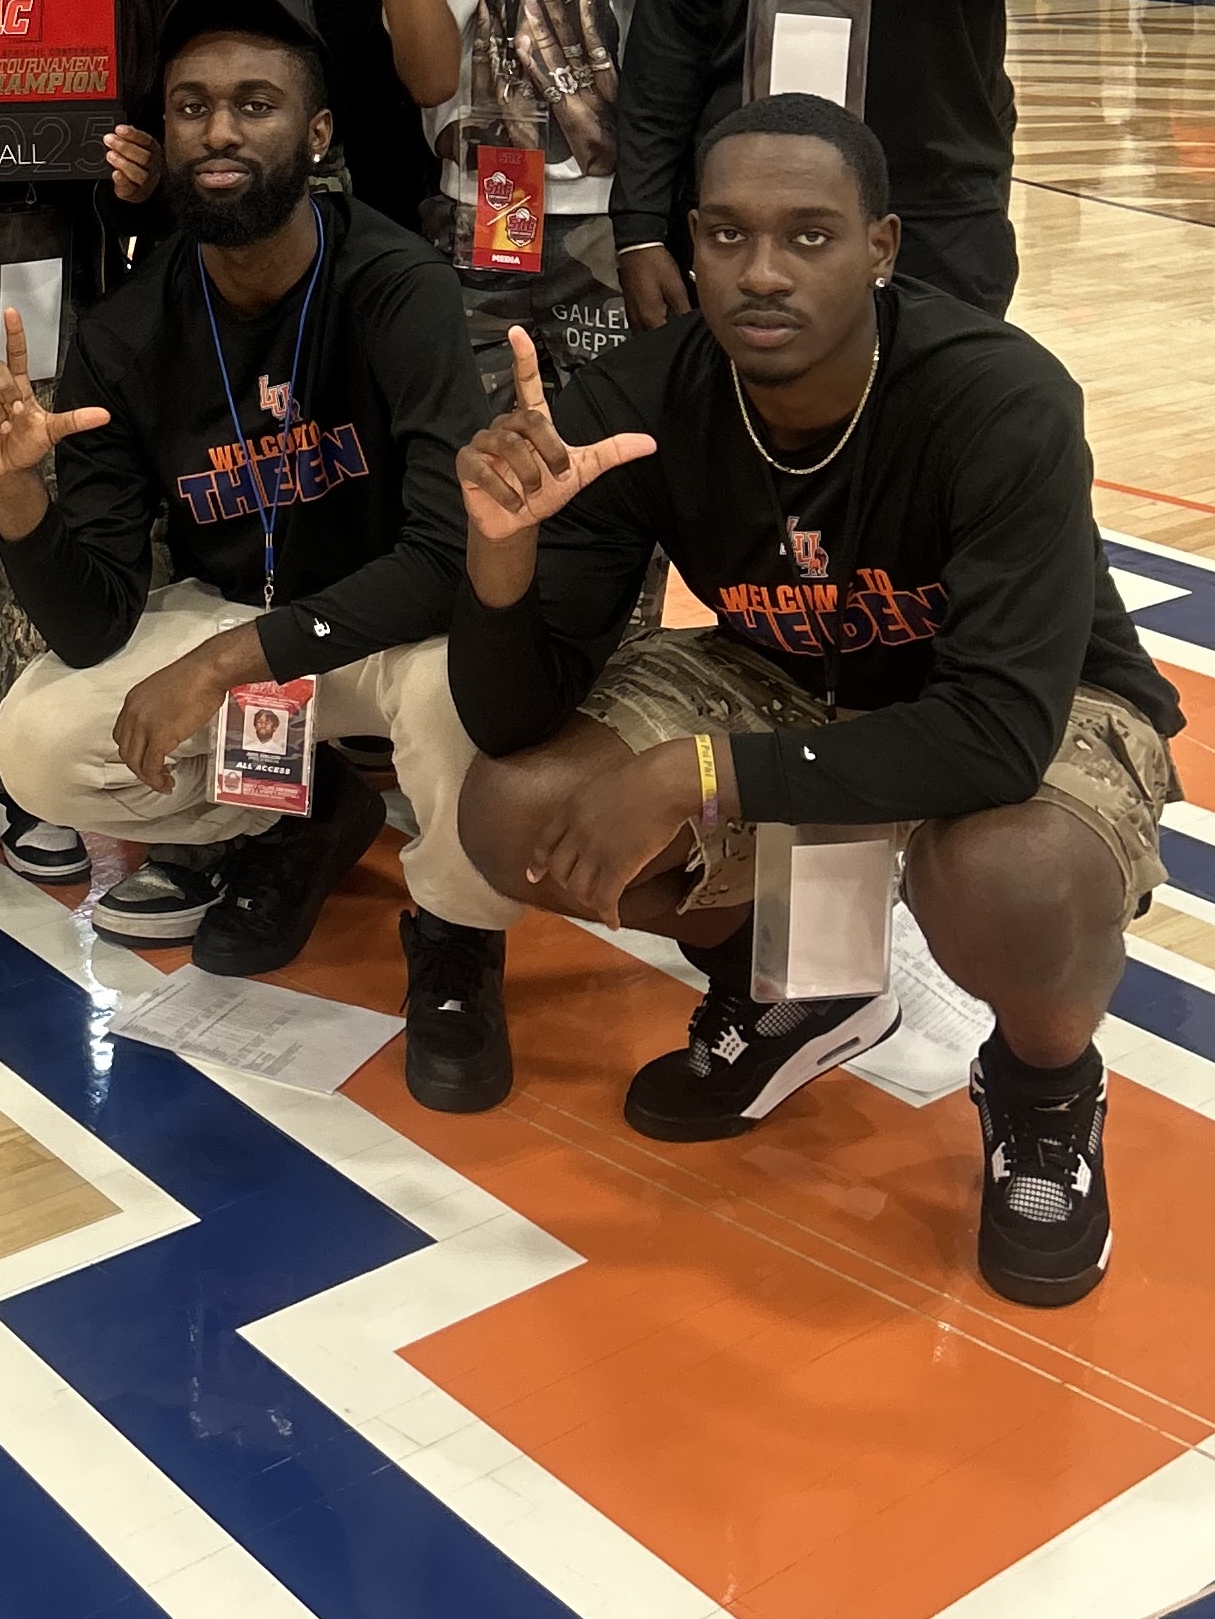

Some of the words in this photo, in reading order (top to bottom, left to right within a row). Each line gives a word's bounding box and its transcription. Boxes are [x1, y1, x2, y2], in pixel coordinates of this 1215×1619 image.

[491, 254, 521, 265] MEDIA
[208, 427, 302, 472] WELCO
[292, 423, 369, 503] EN
[719, 583, 839, 613] WELCOM
[856, 568, 894, 596] TO
[235, 761, 253, 771] ALL
[255, 763, 291, 775] ACCESS
[702, 760, 715, 778] Phi
